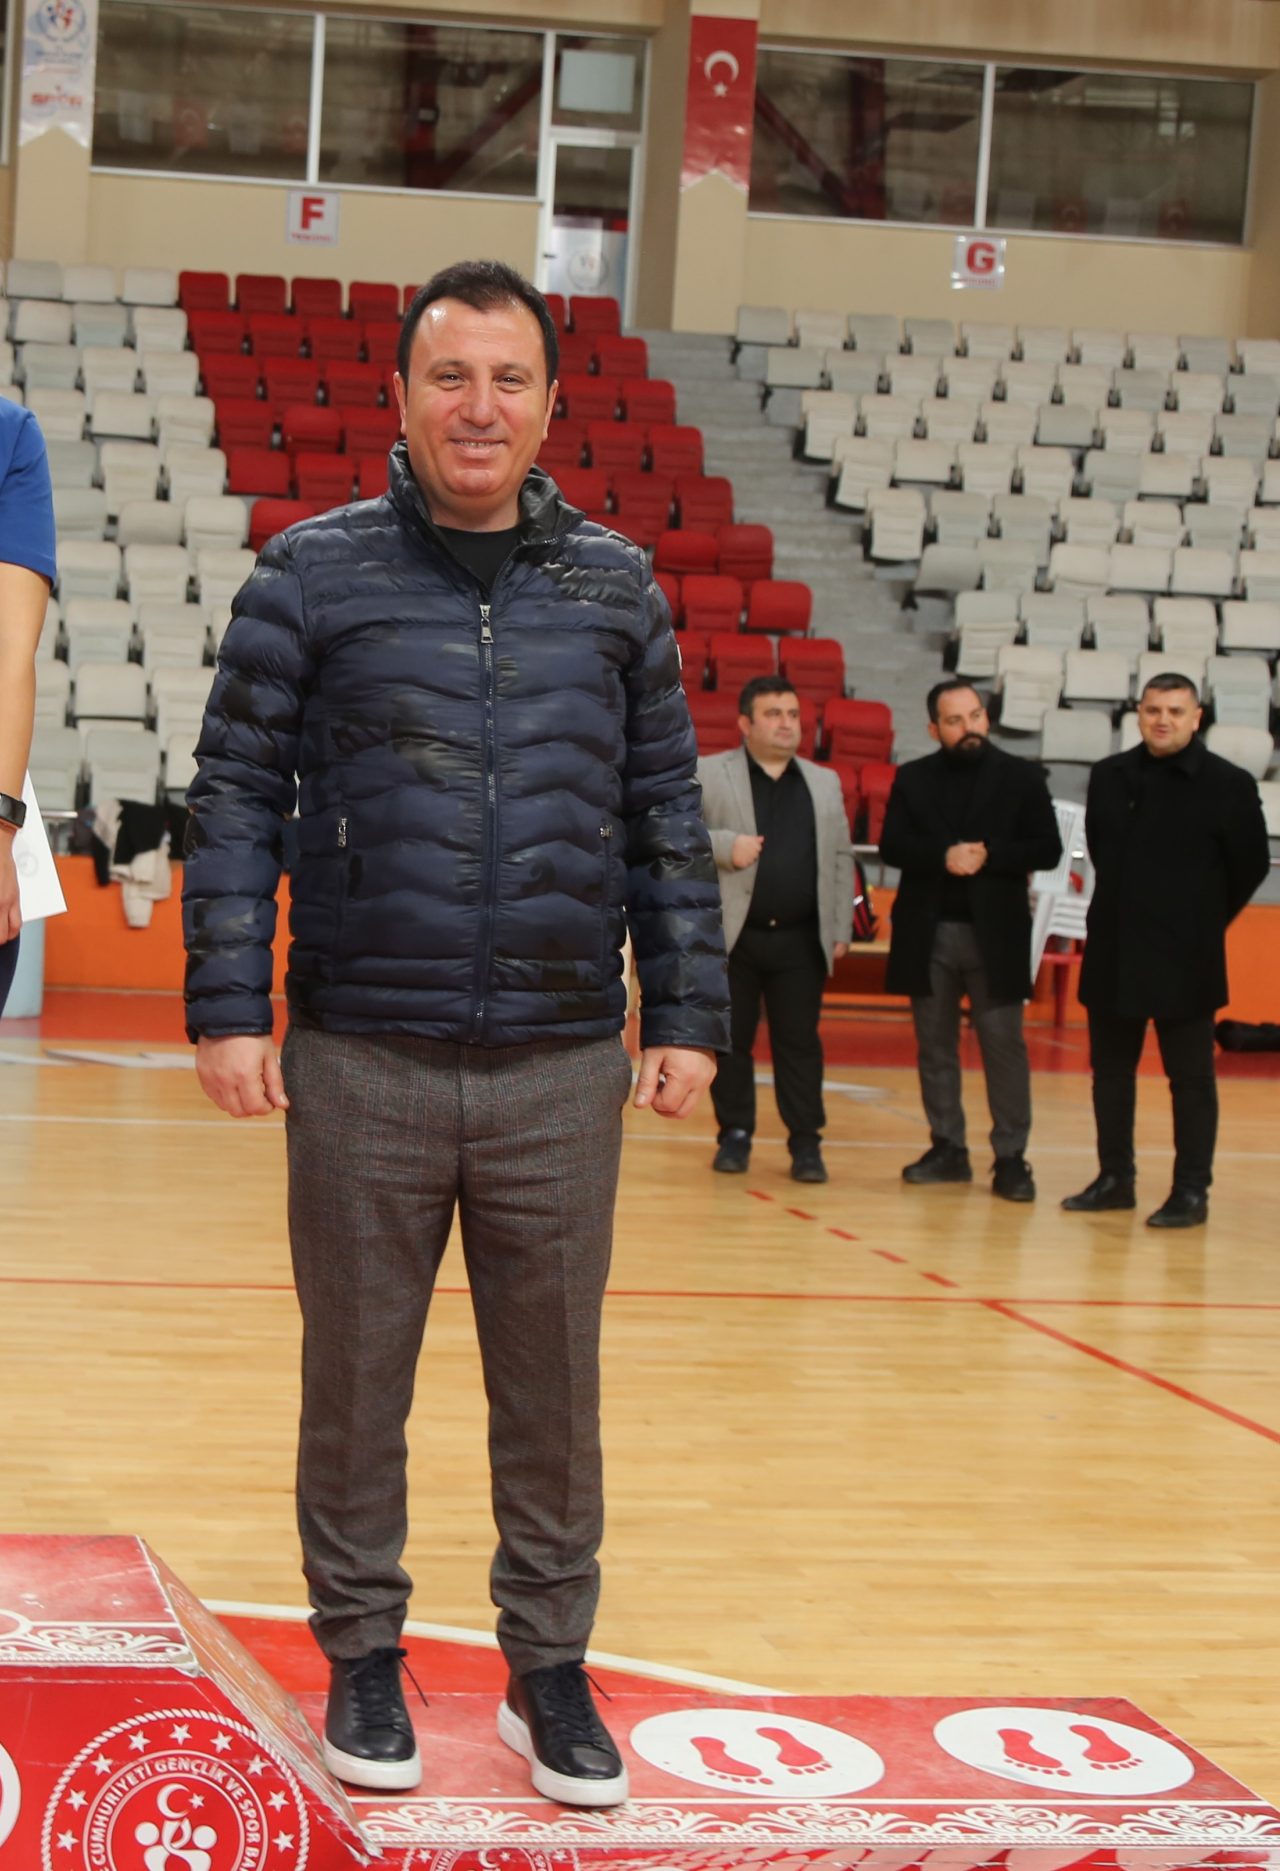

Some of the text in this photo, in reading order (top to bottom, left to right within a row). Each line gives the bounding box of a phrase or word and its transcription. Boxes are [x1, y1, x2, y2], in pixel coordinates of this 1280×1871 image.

[301, 197, 324, 230] F
[967, 241, 996, 275] G
[155, 1756, 228, 1784] GENÇLİK
[224, 1778, 246, 1801] VE
[239, 1798, 261, 1843] SPOR
